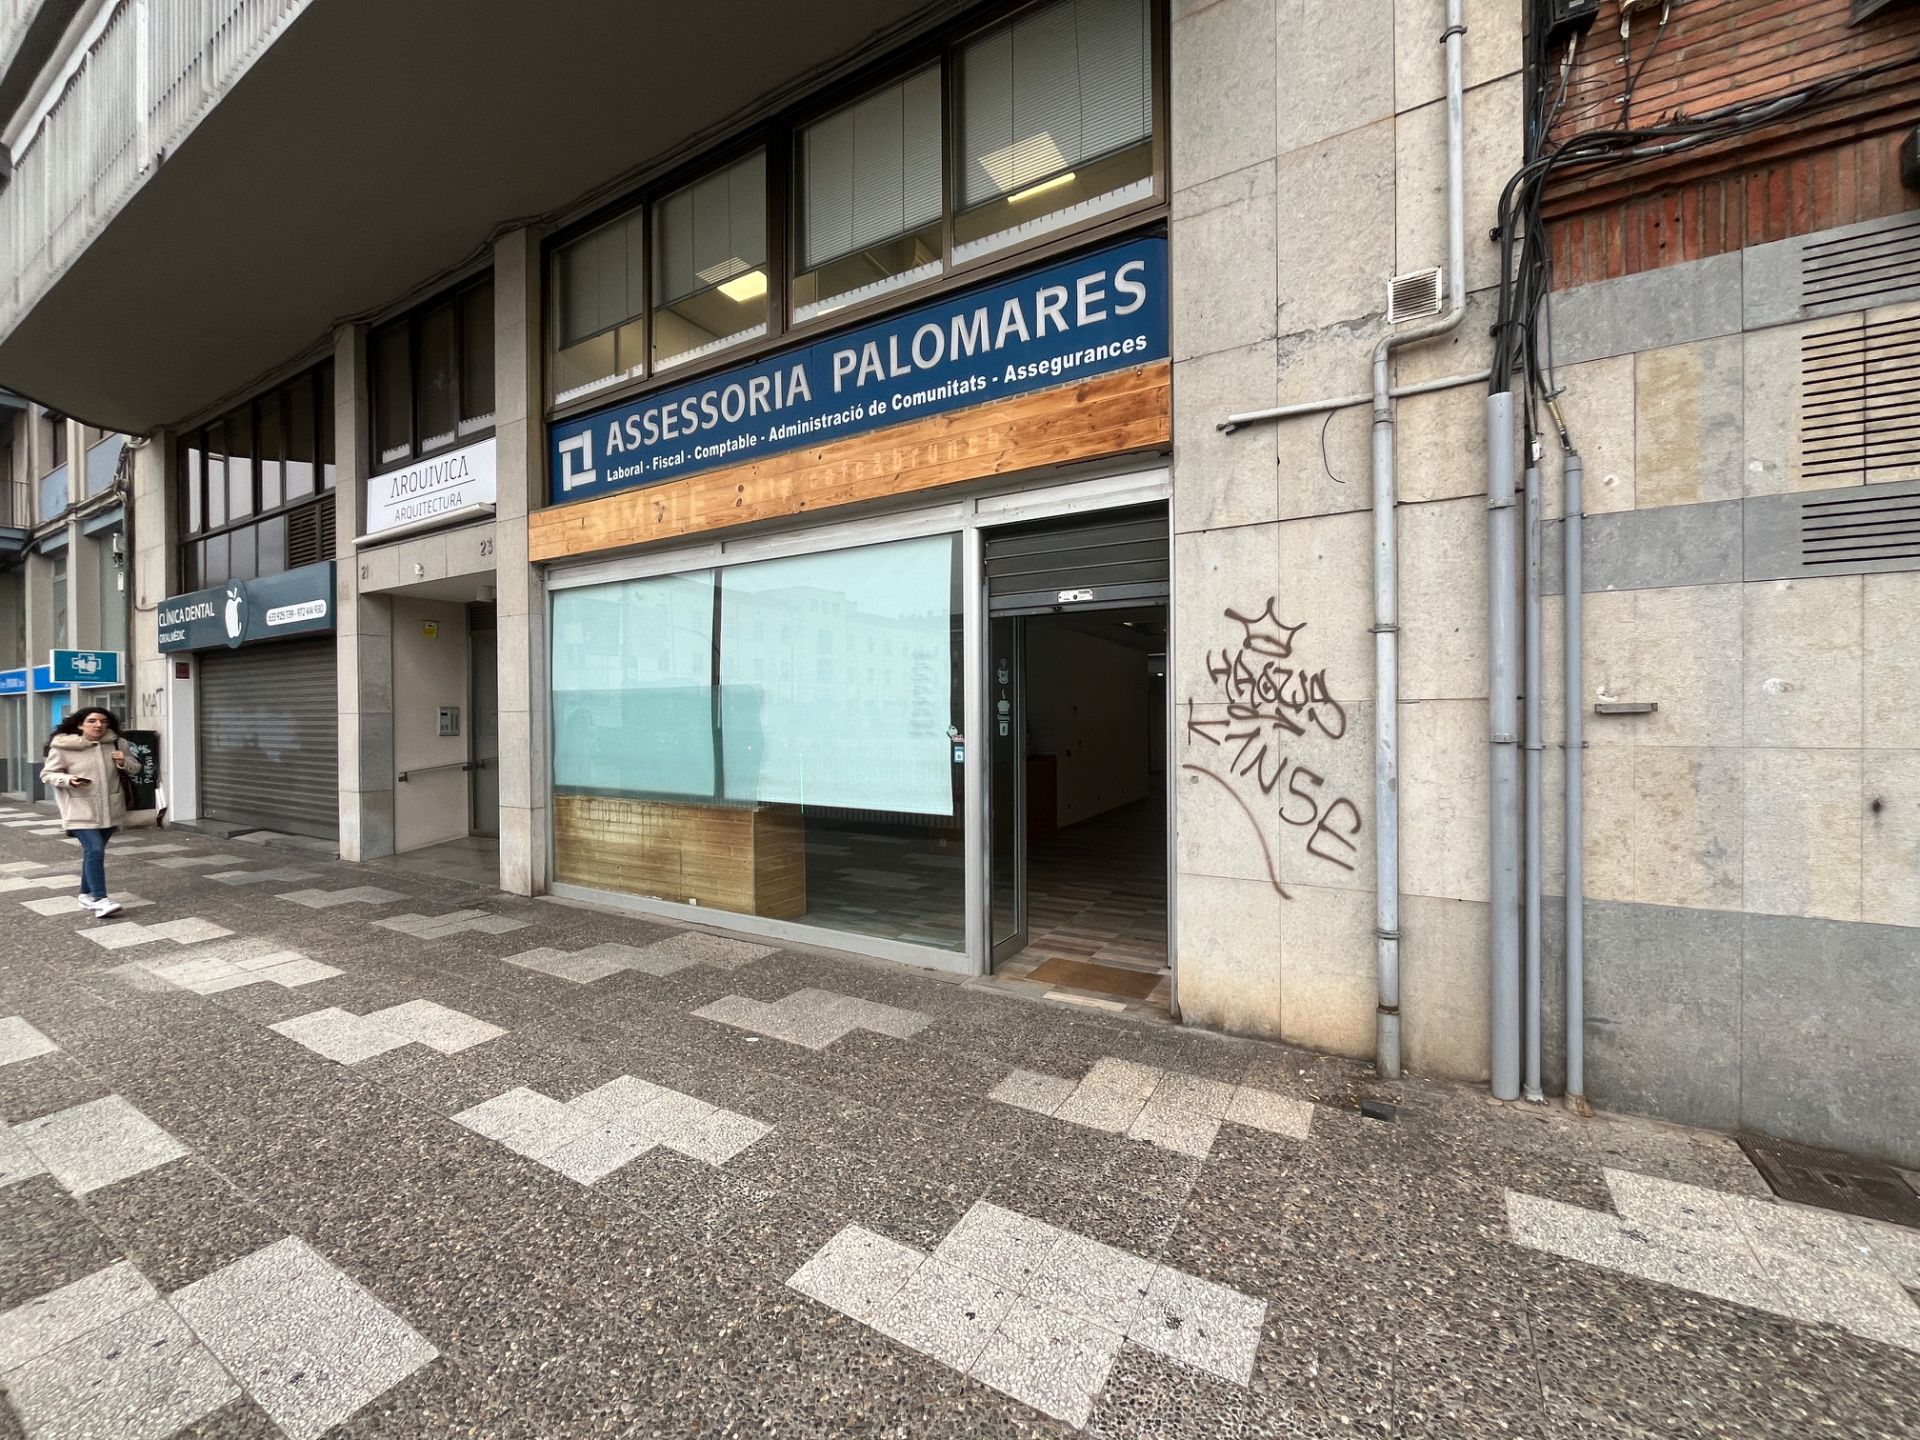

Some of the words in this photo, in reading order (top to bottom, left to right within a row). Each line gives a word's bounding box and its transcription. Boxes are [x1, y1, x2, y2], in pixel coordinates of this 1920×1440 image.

[606, 363, 812, 456] ASSESSORIA
[833, 260, 1147, 393] PALOMARES
[606, 459, 644, 482] Laboral
[652, 450, 685, 471] Fiscal
[694, 433, 757, 461] Comptable
[769, 404, 864, 442] Administració
[868, 399, 887, 417] de
[891, 373, 987, 410] Comunitats
[1003, 334, 1147, 384] Assegurances
[390, 455, 469, 498] ARQUIVICA
[394, 491, 462, 522] ARQUITECTURA
[480, 537, 493, 556] 23
[159, 608, 185, 628] CLÍNICA
[185, 602, 215, 622] DENTAL
